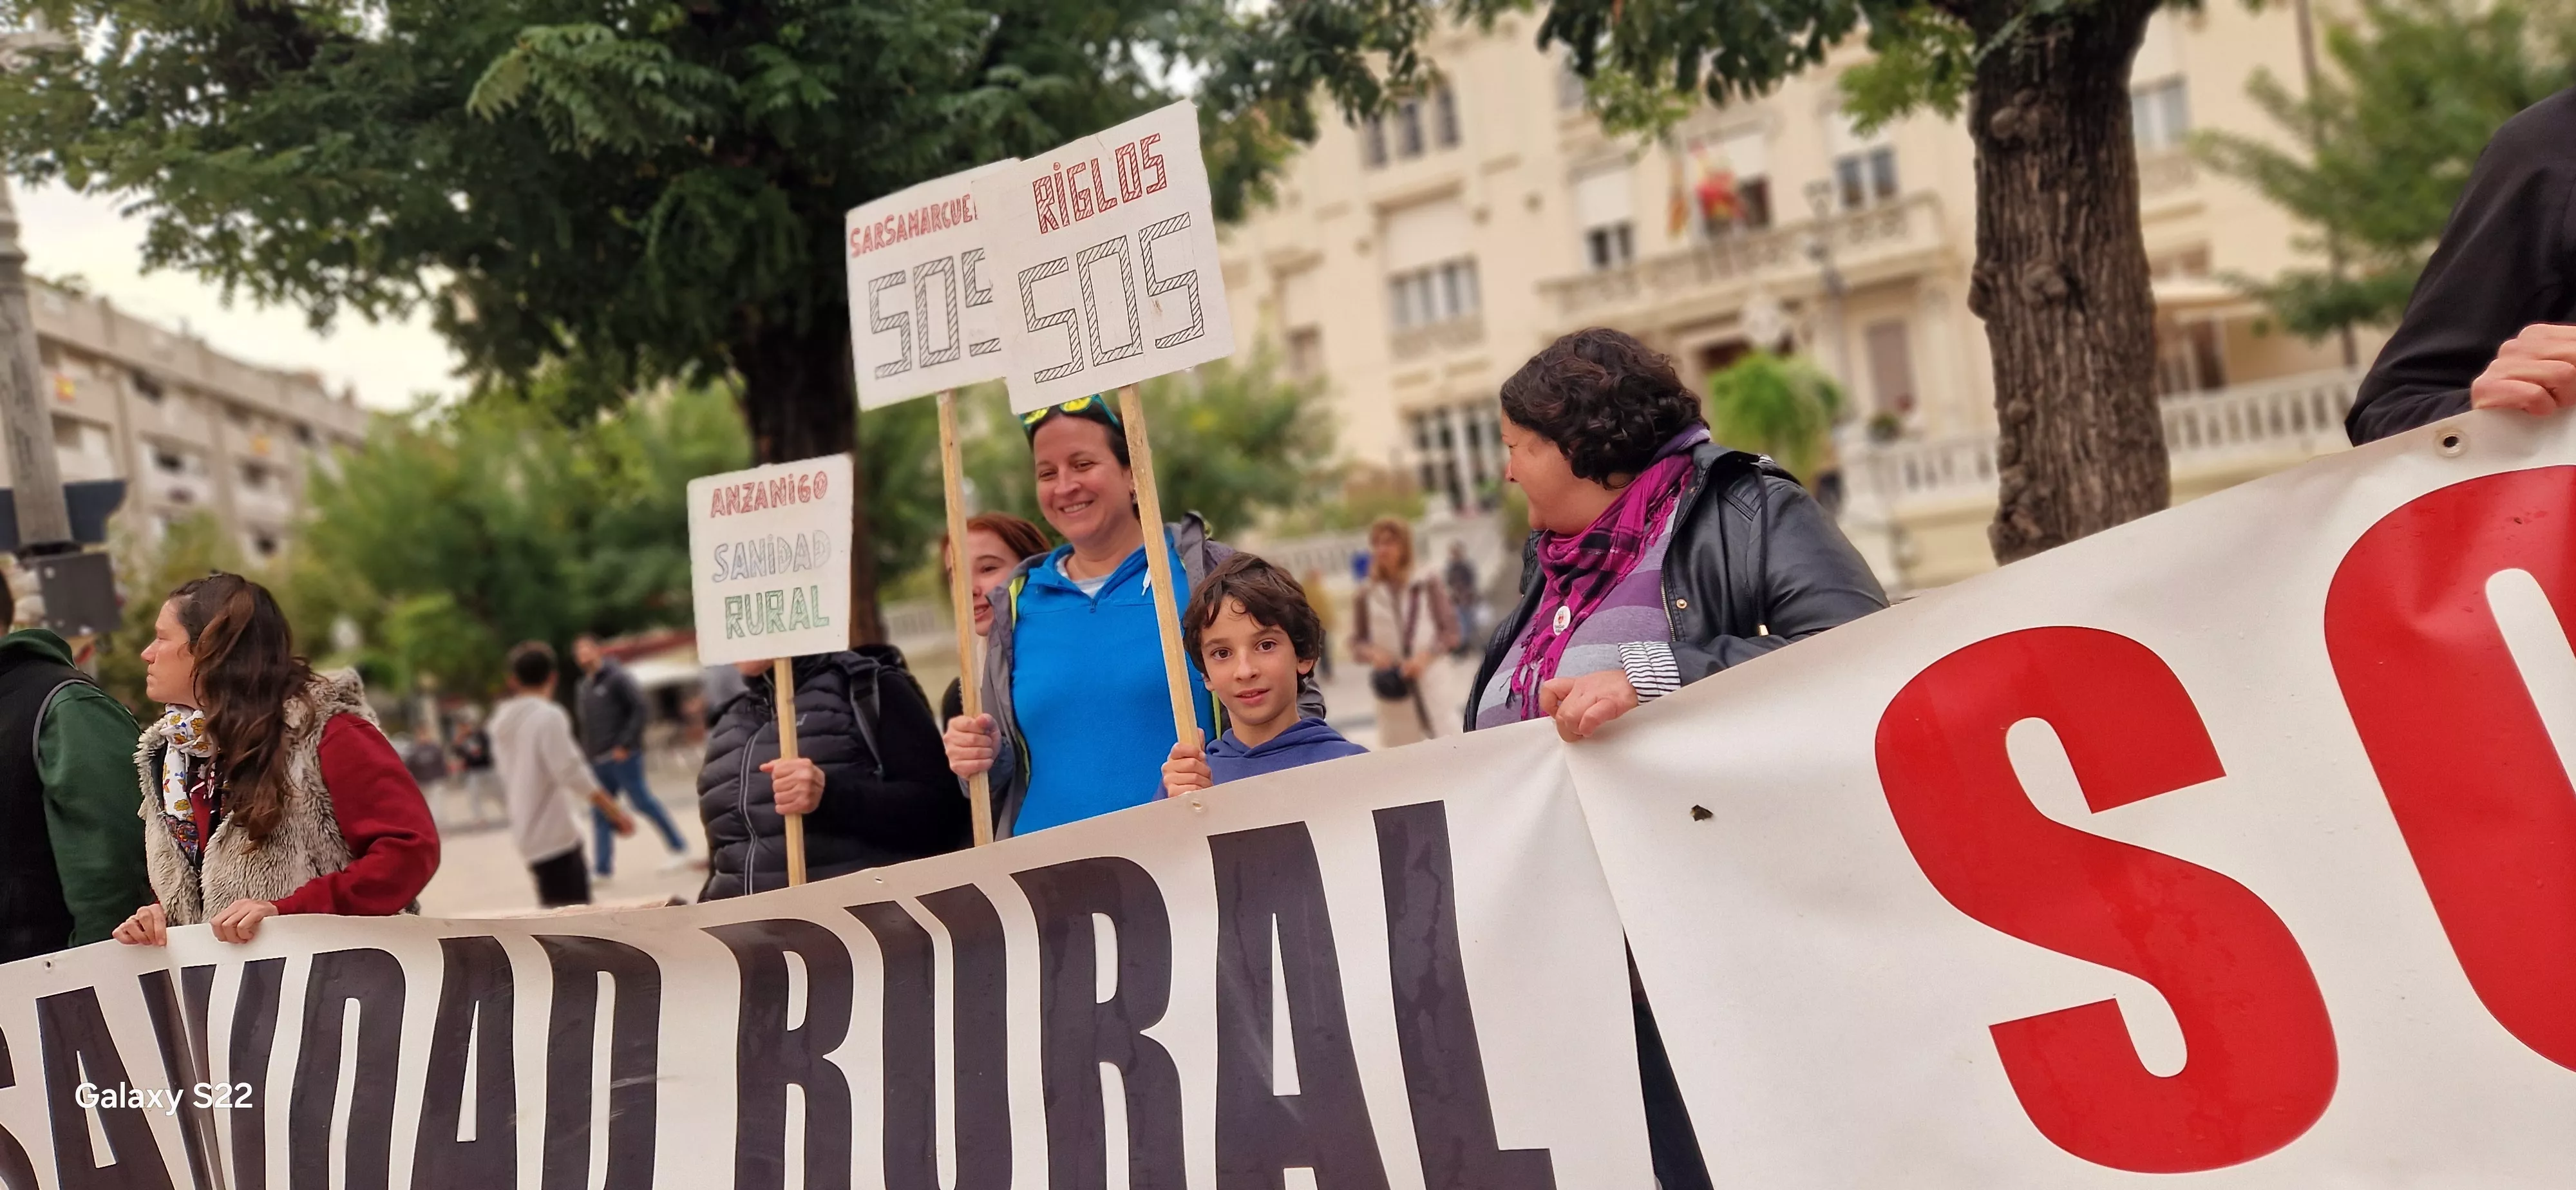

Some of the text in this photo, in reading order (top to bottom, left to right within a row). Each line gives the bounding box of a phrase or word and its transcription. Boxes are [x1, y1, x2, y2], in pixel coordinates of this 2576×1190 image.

[1019, 212, 1204, 384] SOS
[724, 585, 830, 639] RURAL
[700, 800, 1556, 1190] RURAL
